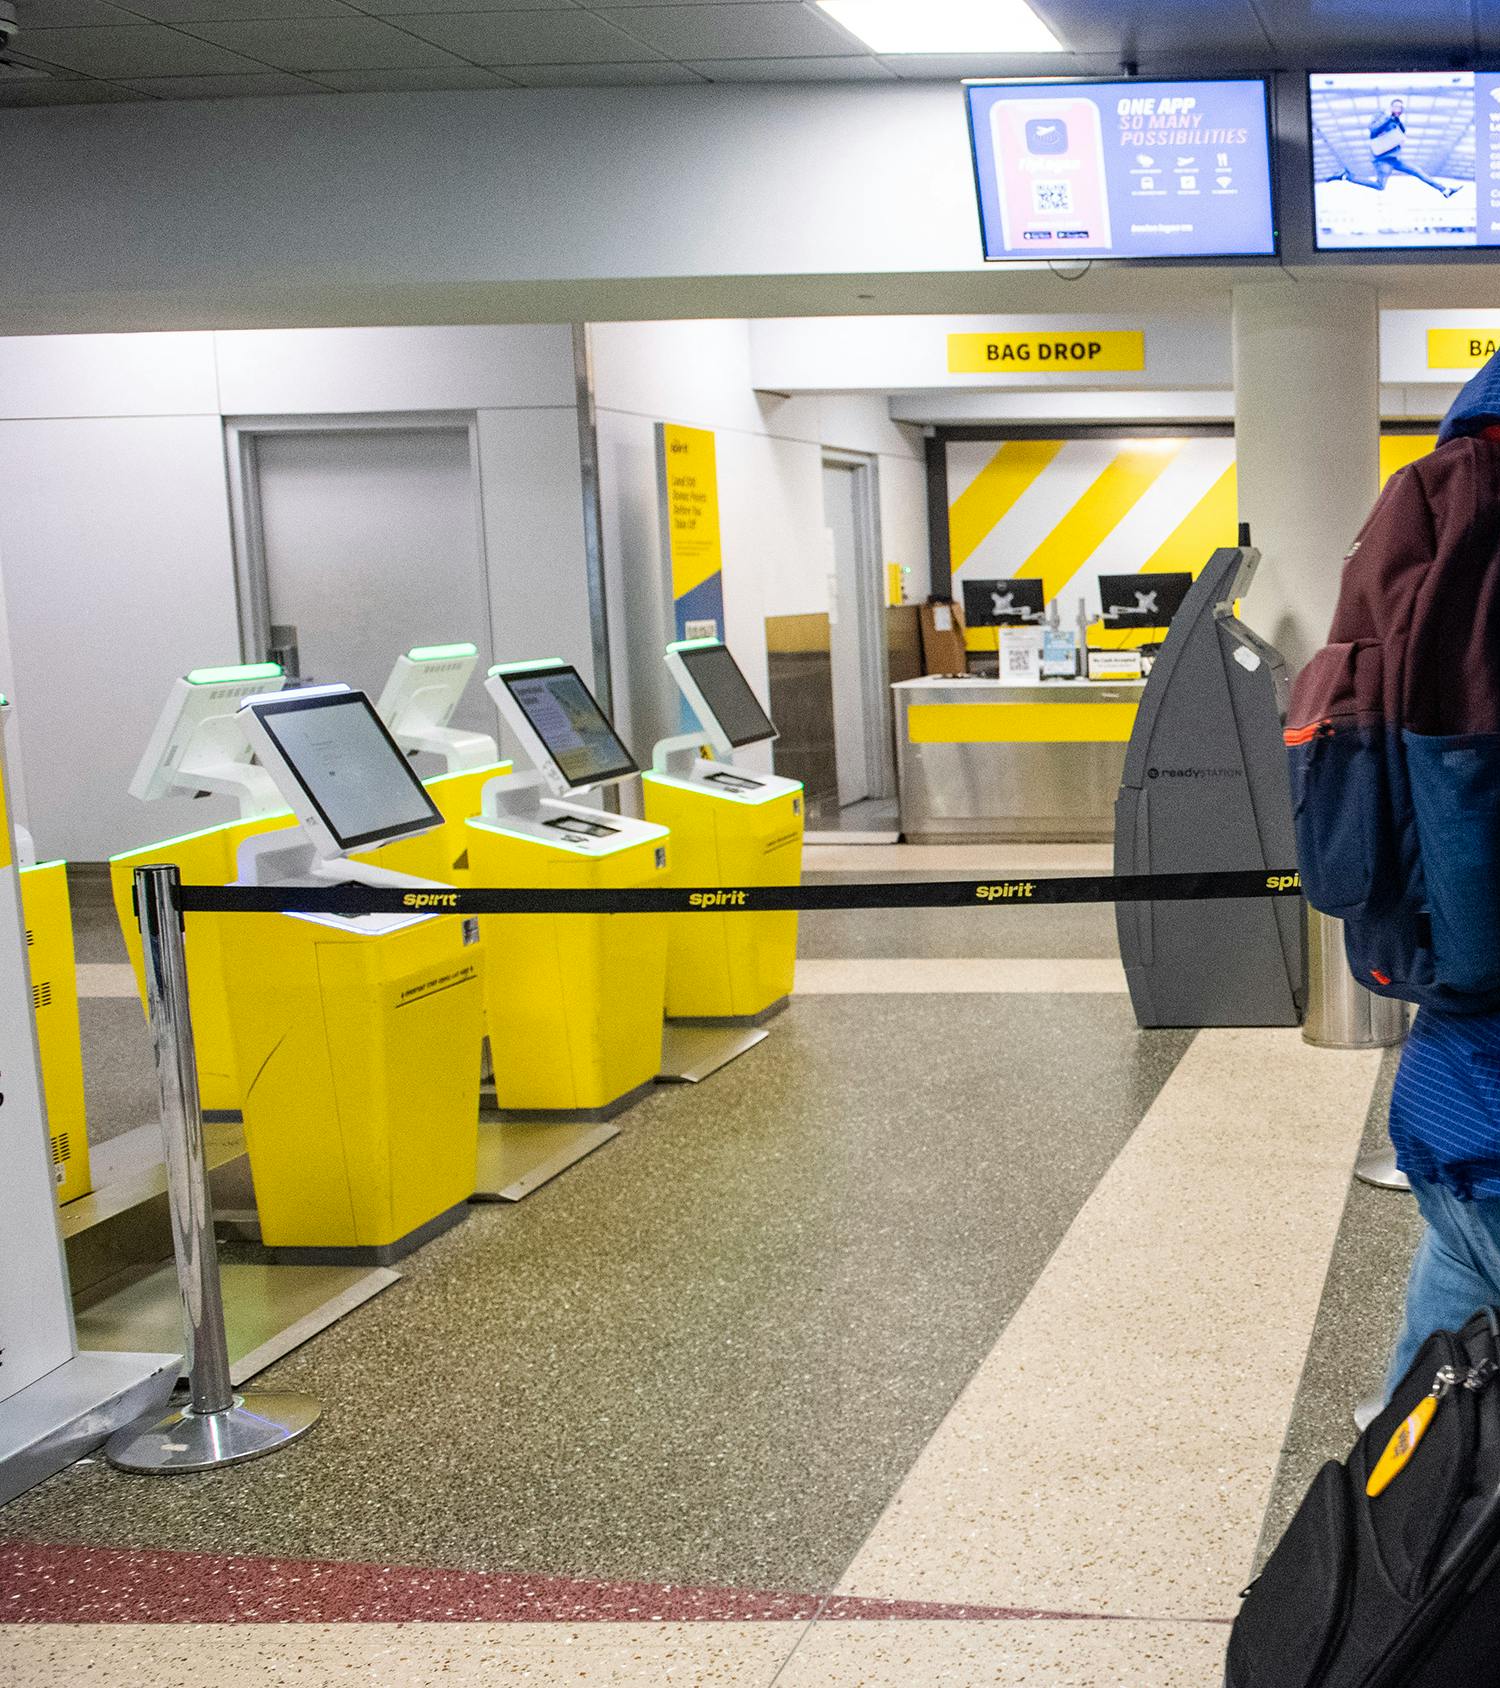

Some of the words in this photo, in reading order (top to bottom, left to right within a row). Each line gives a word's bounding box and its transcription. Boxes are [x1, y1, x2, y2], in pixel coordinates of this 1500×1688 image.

[1118, 98, 1155, 116] ONE
[1157, 97, 1197, 115] APP
[1119, 114, 1143, 130] SO
[1149, 112, 1203, 129] MANY
[1120, 127, 1249, 146] POSSIBILITIES
[1490, 199, 1500, 208] to
[986, 342, 1031, 361] BAG
[1038, 341, 1102, 361] DROP
[1470, 340, 1496, 356] BA
[975, 882, 1034, 901] spirit
[1265, 873, 1302, 892] spi
[403, 893, 458, 909] spirit
[689, 890, 746, 908] spirit
